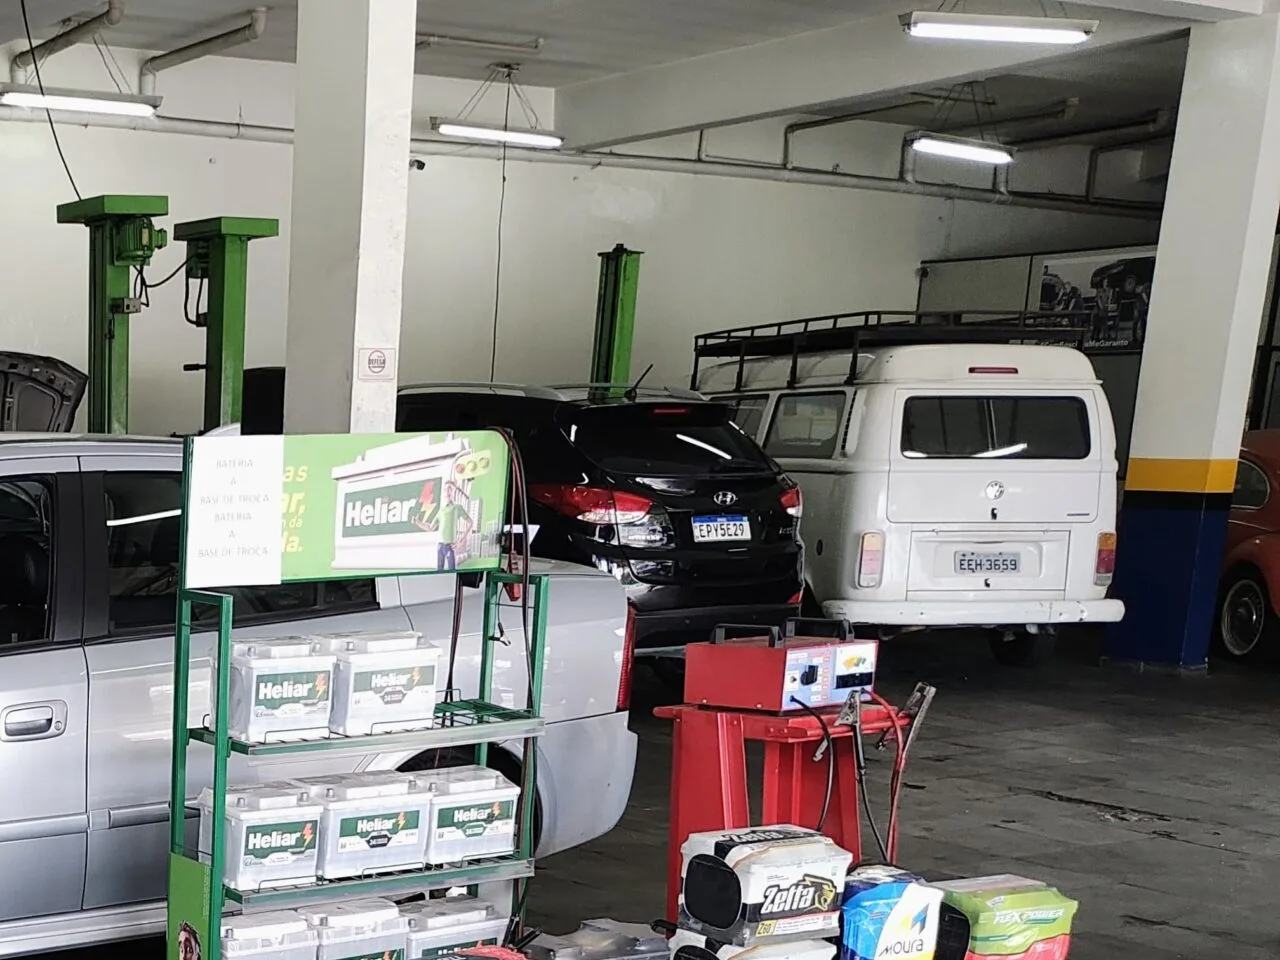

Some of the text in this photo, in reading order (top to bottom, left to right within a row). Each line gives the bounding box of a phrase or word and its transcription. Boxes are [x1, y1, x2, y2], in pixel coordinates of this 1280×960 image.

[345, 492, 418, 529] Heliar
[699, 523, 745, 538] EPY5E29
[371, 673, 411, 688] Heliar
[258, 680, 313, 700] Heliar
[453, 808, 492, 823] Heliar
[356, 818, 396, 833] Heliar
[248, 830, 301, 850] Heliar
[760, 885, 815, 914] Zetta
[878, 939, 924, 957] moura
